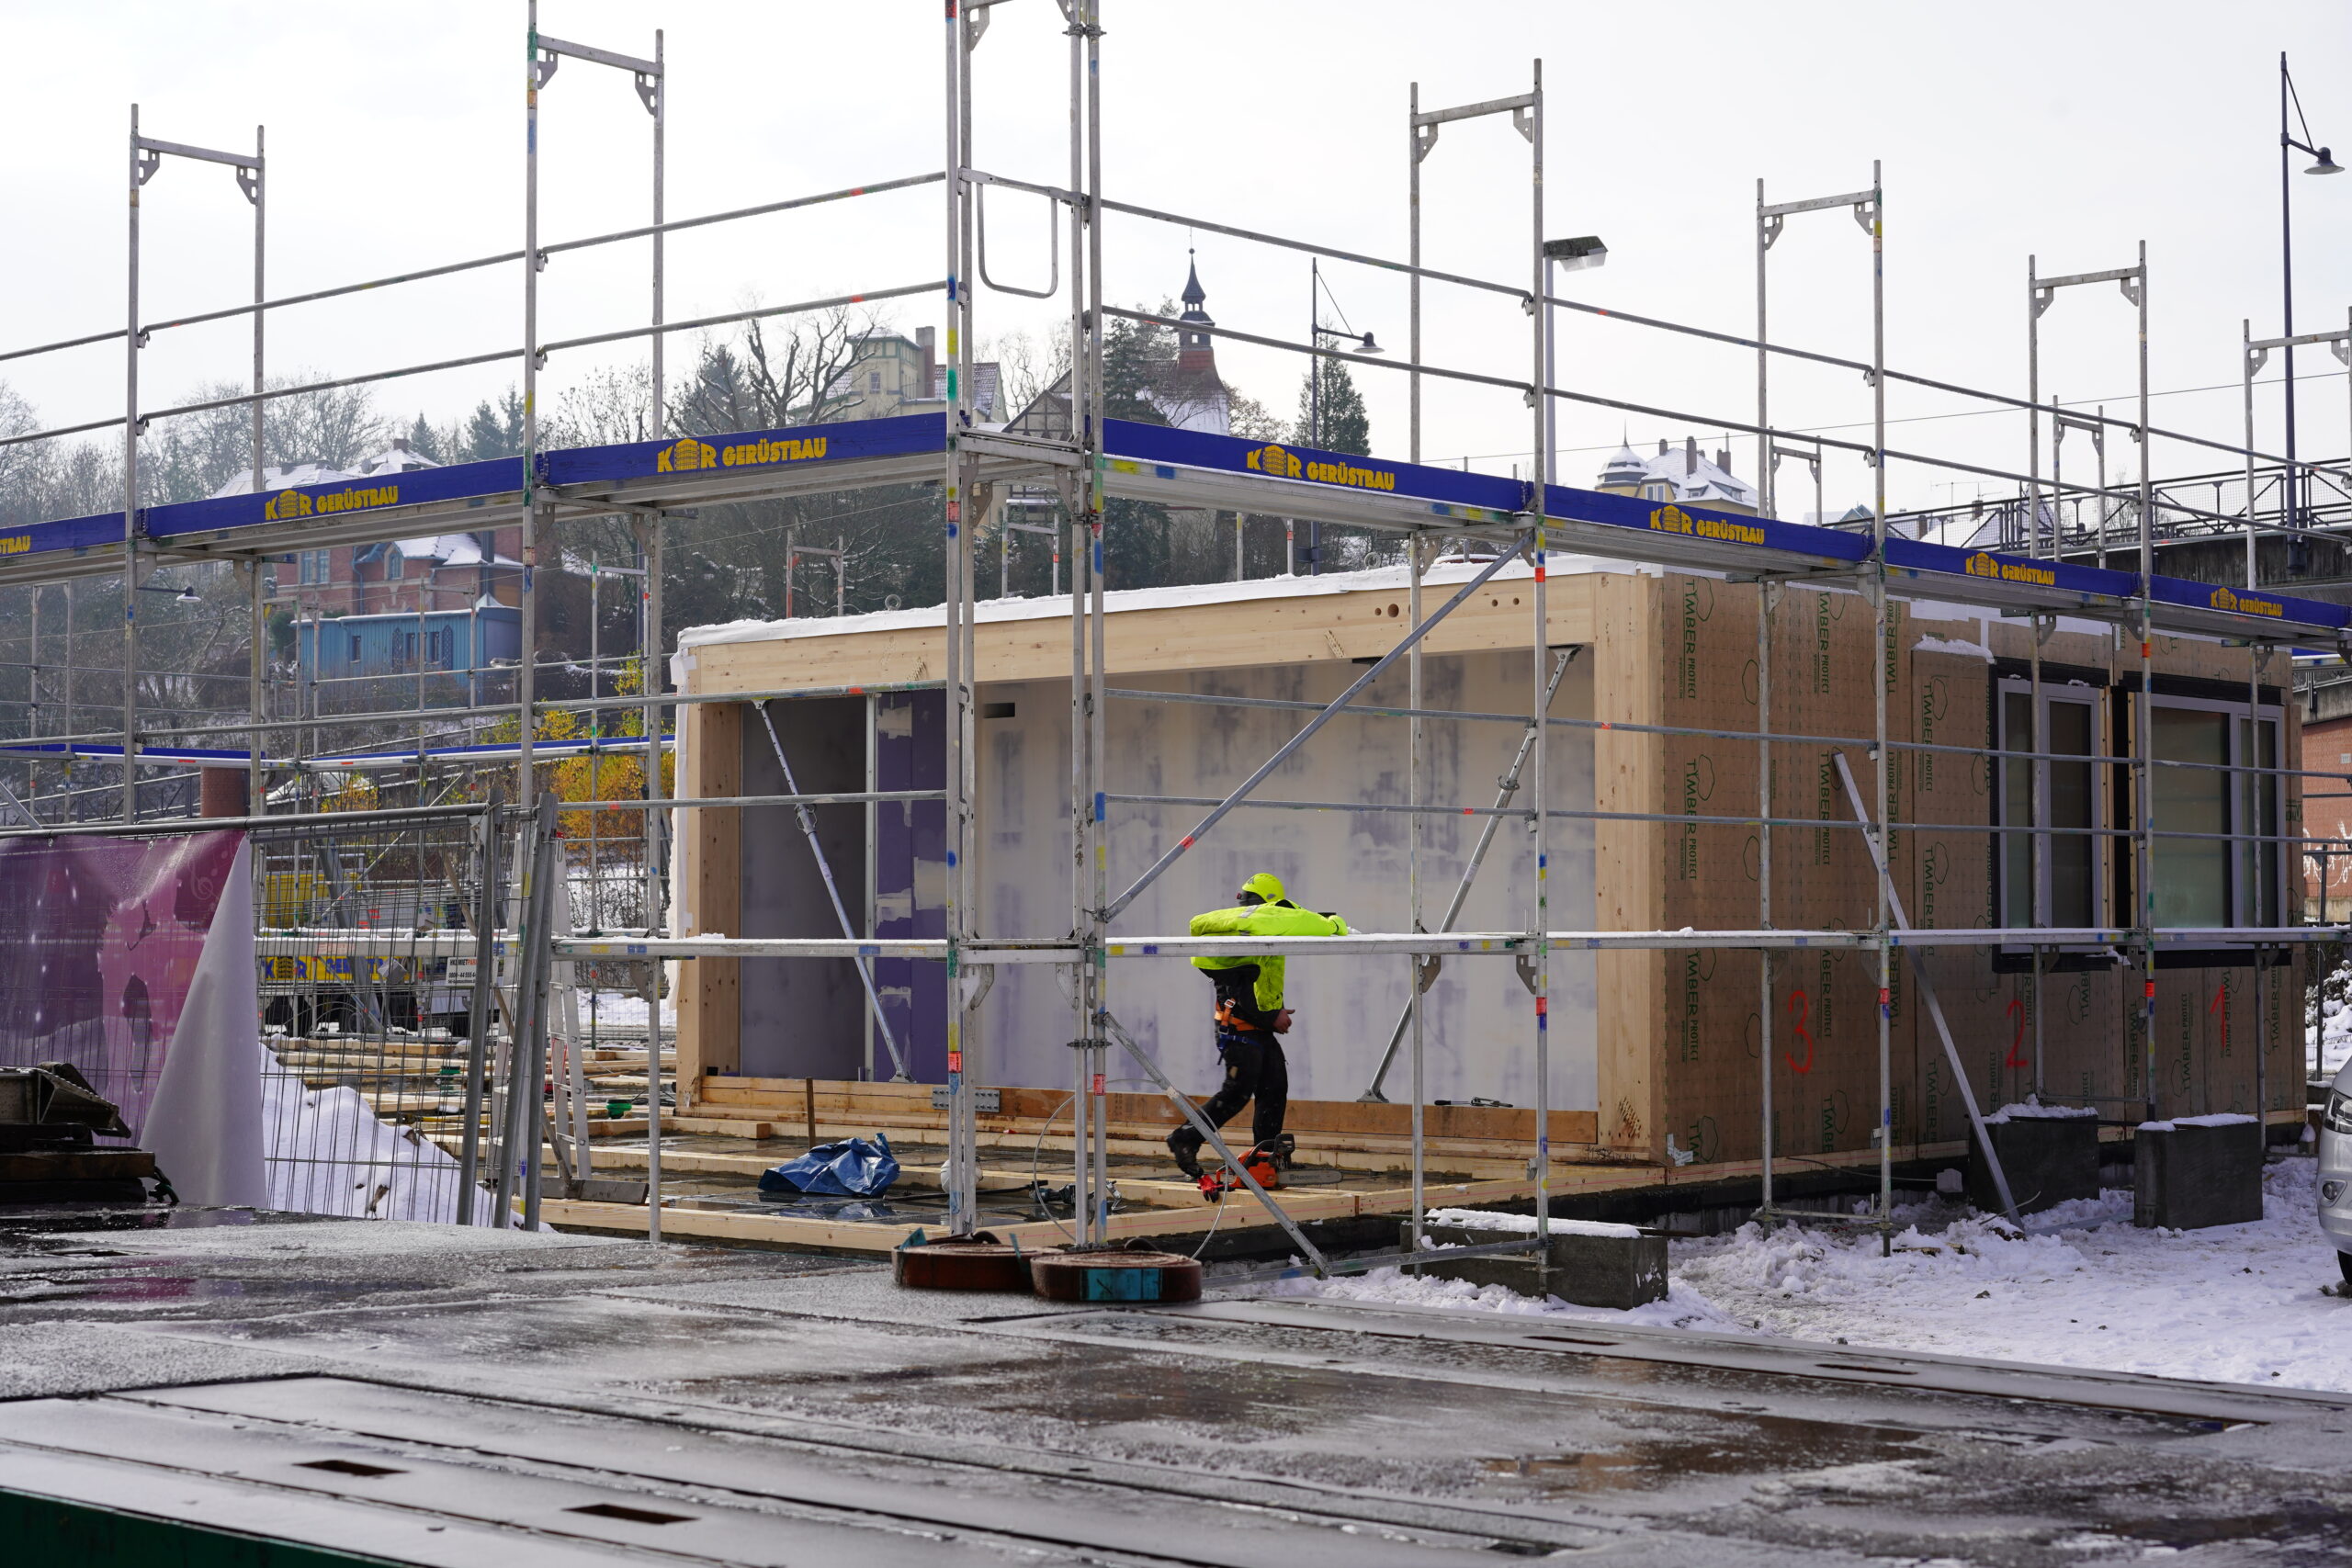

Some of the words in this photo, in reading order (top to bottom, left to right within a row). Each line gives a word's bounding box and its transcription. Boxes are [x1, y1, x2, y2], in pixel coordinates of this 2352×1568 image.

[722, 437, 826, 467] GERÜSTBAU
[1306, 461, 1395, 491] GERÜSTBAU
[316, 485, 399, 513] GERÜSTBAU
[1696, 519, 1765, 545] GERÜSTBAU
[2001, 563, 2055, 585] GERÜSTBAU
[1688, 657, 1696, 699] PROTECT
[1821, 654, 1829, 695] PROTECT
[1886, 750, 1895, 790] PROTECT
[1925, 753, 1933, 793] PROTECT
[1688, 838, 1697, 881] PROTECT
[1822, 826, 1830, 866] PROTECT
[1785, 989, 1814, 1074] 3
[1824, 998, 1832, 1038] PROTECT
[2005, 999, 2029, 1068] 2
[2210, 984, 2227, 1049] 1
[1690, 1020, 1699, 1062] PROTECT
